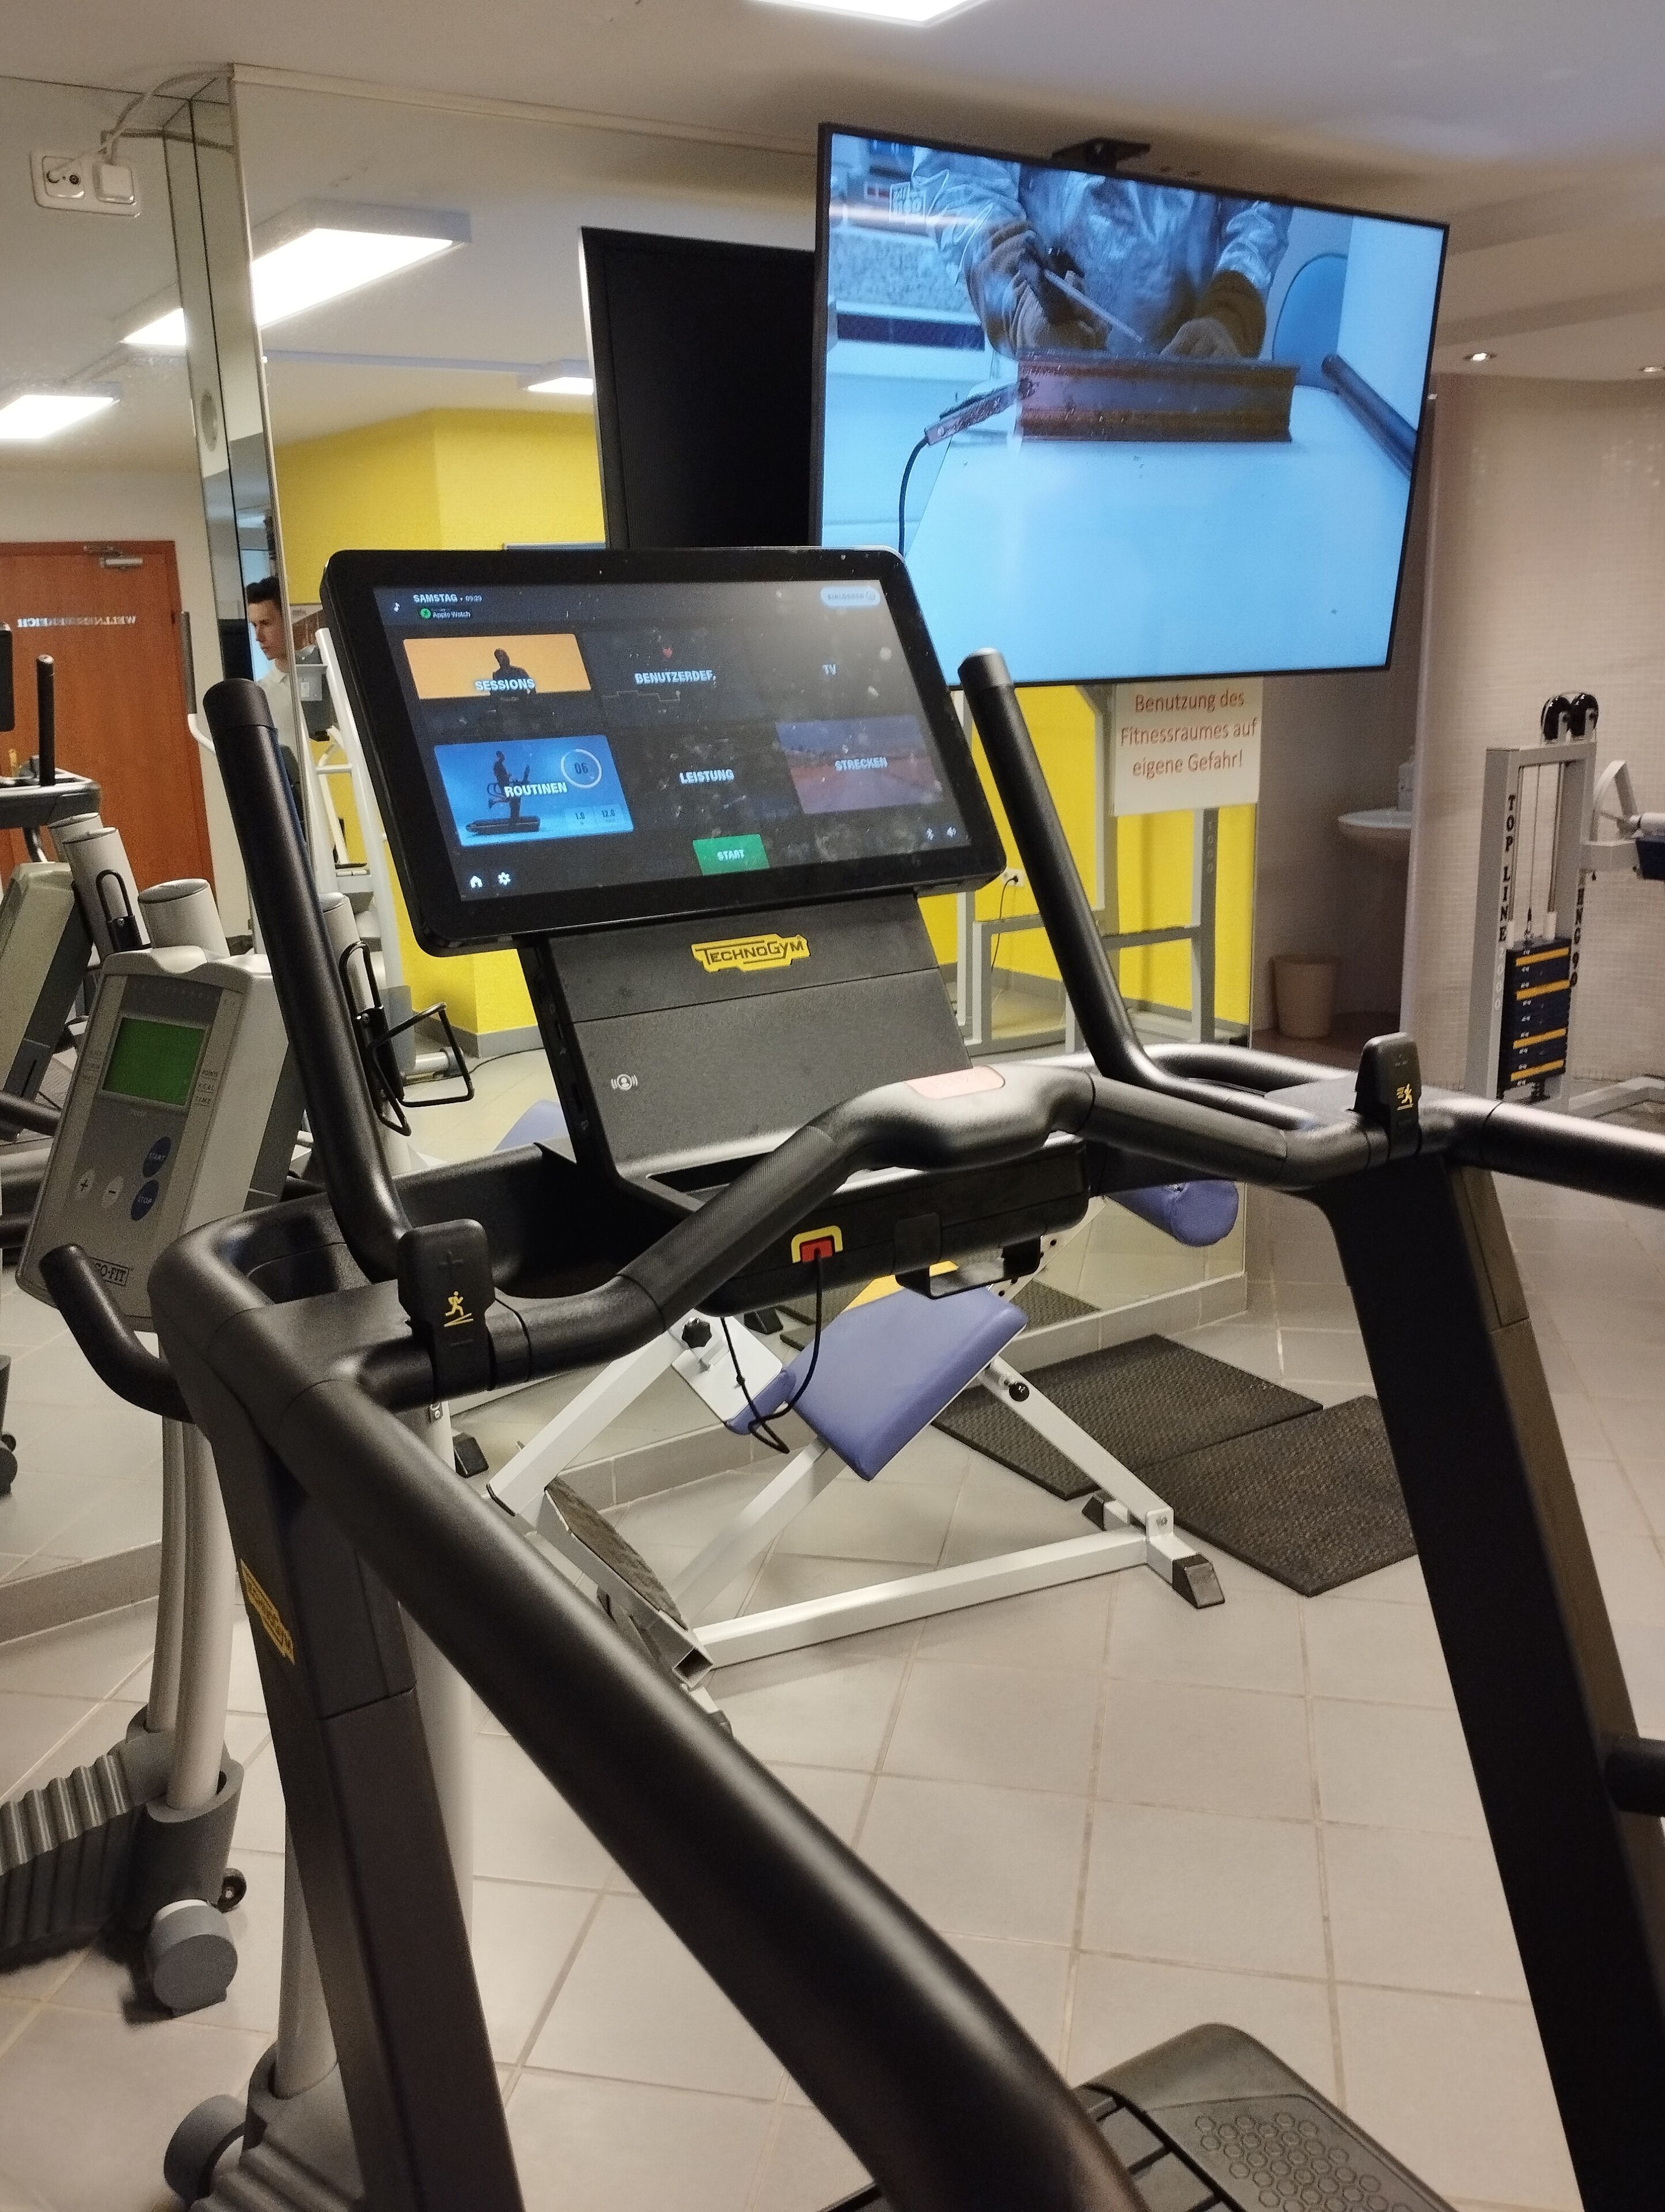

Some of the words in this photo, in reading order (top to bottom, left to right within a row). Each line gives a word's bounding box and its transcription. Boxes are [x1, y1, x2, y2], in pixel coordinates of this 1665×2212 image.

[413, 593, 458, 604] SAMSTAG
[822, 664, 836, 676] TV
[475, 679, 536, 691] SESSIONS
[1135, 694, 1216, 713] Benutzung
[1220, 688, 1245, 707] des
[1121, 723, 1228, 746] Fitnessraumes
[1233, 717, 1257, 738] auf
[835, 757, 888, 771] STRECKEN
[1133, 756, 1182, 779] eigene
[1188, 749, 1242, 772] Gefahr!
[680, 769, 734, 784] LEISTUNG
[504, 782, 568, 798] ROUTINEN
[1505, 794, 1516, 853] TOP
[717, 850, 745, 861] START
[1499, 866, 1510, 941] LINE
[695, 939, 805, 965] TECHNOGYM
